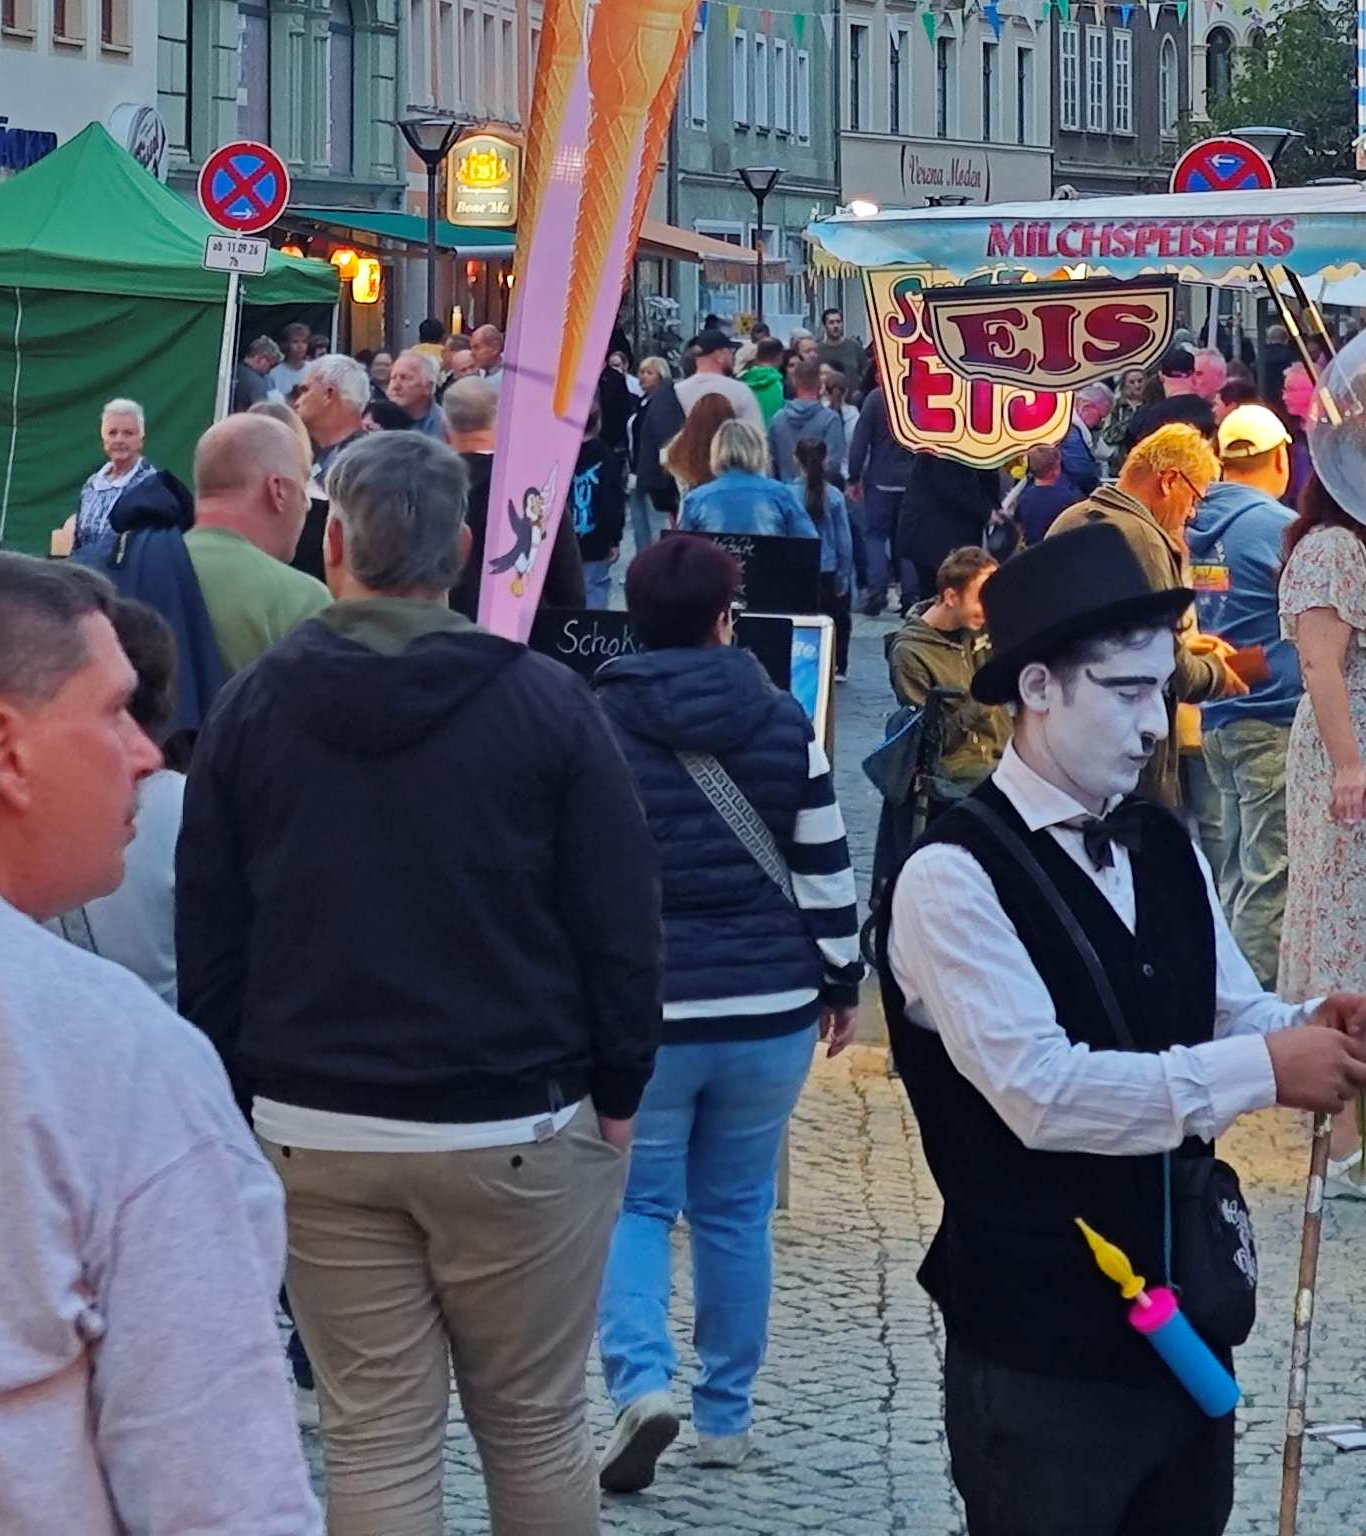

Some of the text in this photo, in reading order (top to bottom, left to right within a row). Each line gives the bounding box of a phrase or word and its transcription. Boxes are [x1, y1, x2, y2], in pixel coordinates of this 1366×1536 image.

[908, 154, 981, 188] Verena Moden
[212, 241, 223, 252] ab
[985, 219, 1295, 258] MILCHSPEISEEIS
[946, 303, 1157, 375] EIS
